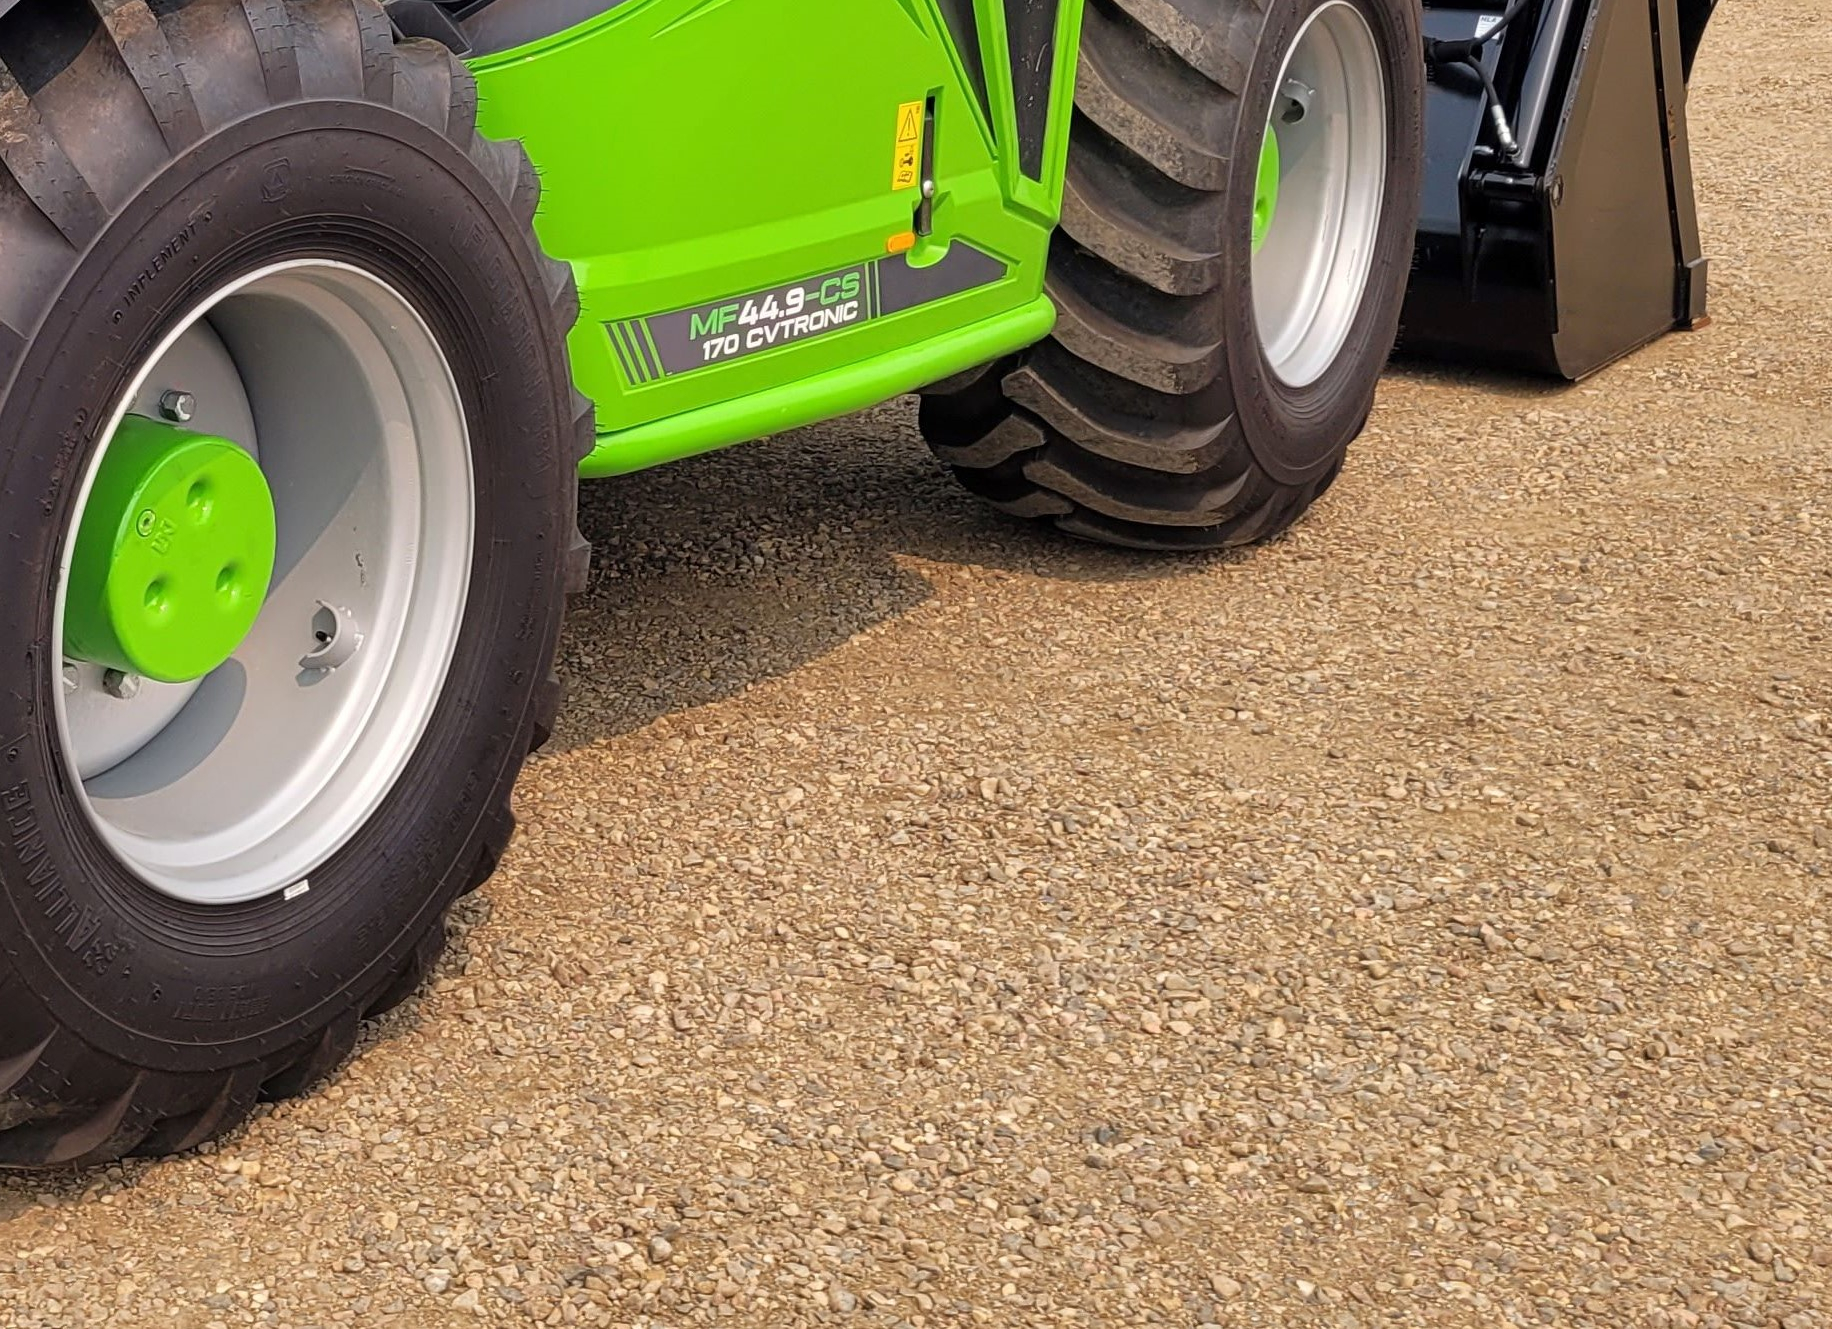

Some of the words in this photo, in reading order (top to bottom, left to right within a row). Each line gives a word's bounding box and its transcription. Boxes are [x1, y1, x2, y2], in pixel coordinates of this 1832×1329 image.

[689, 272, 860, 341] MF44.9-CS
[703, 333, 740, 360] 170
[746, 300, 859, 349] CVTRONIC
